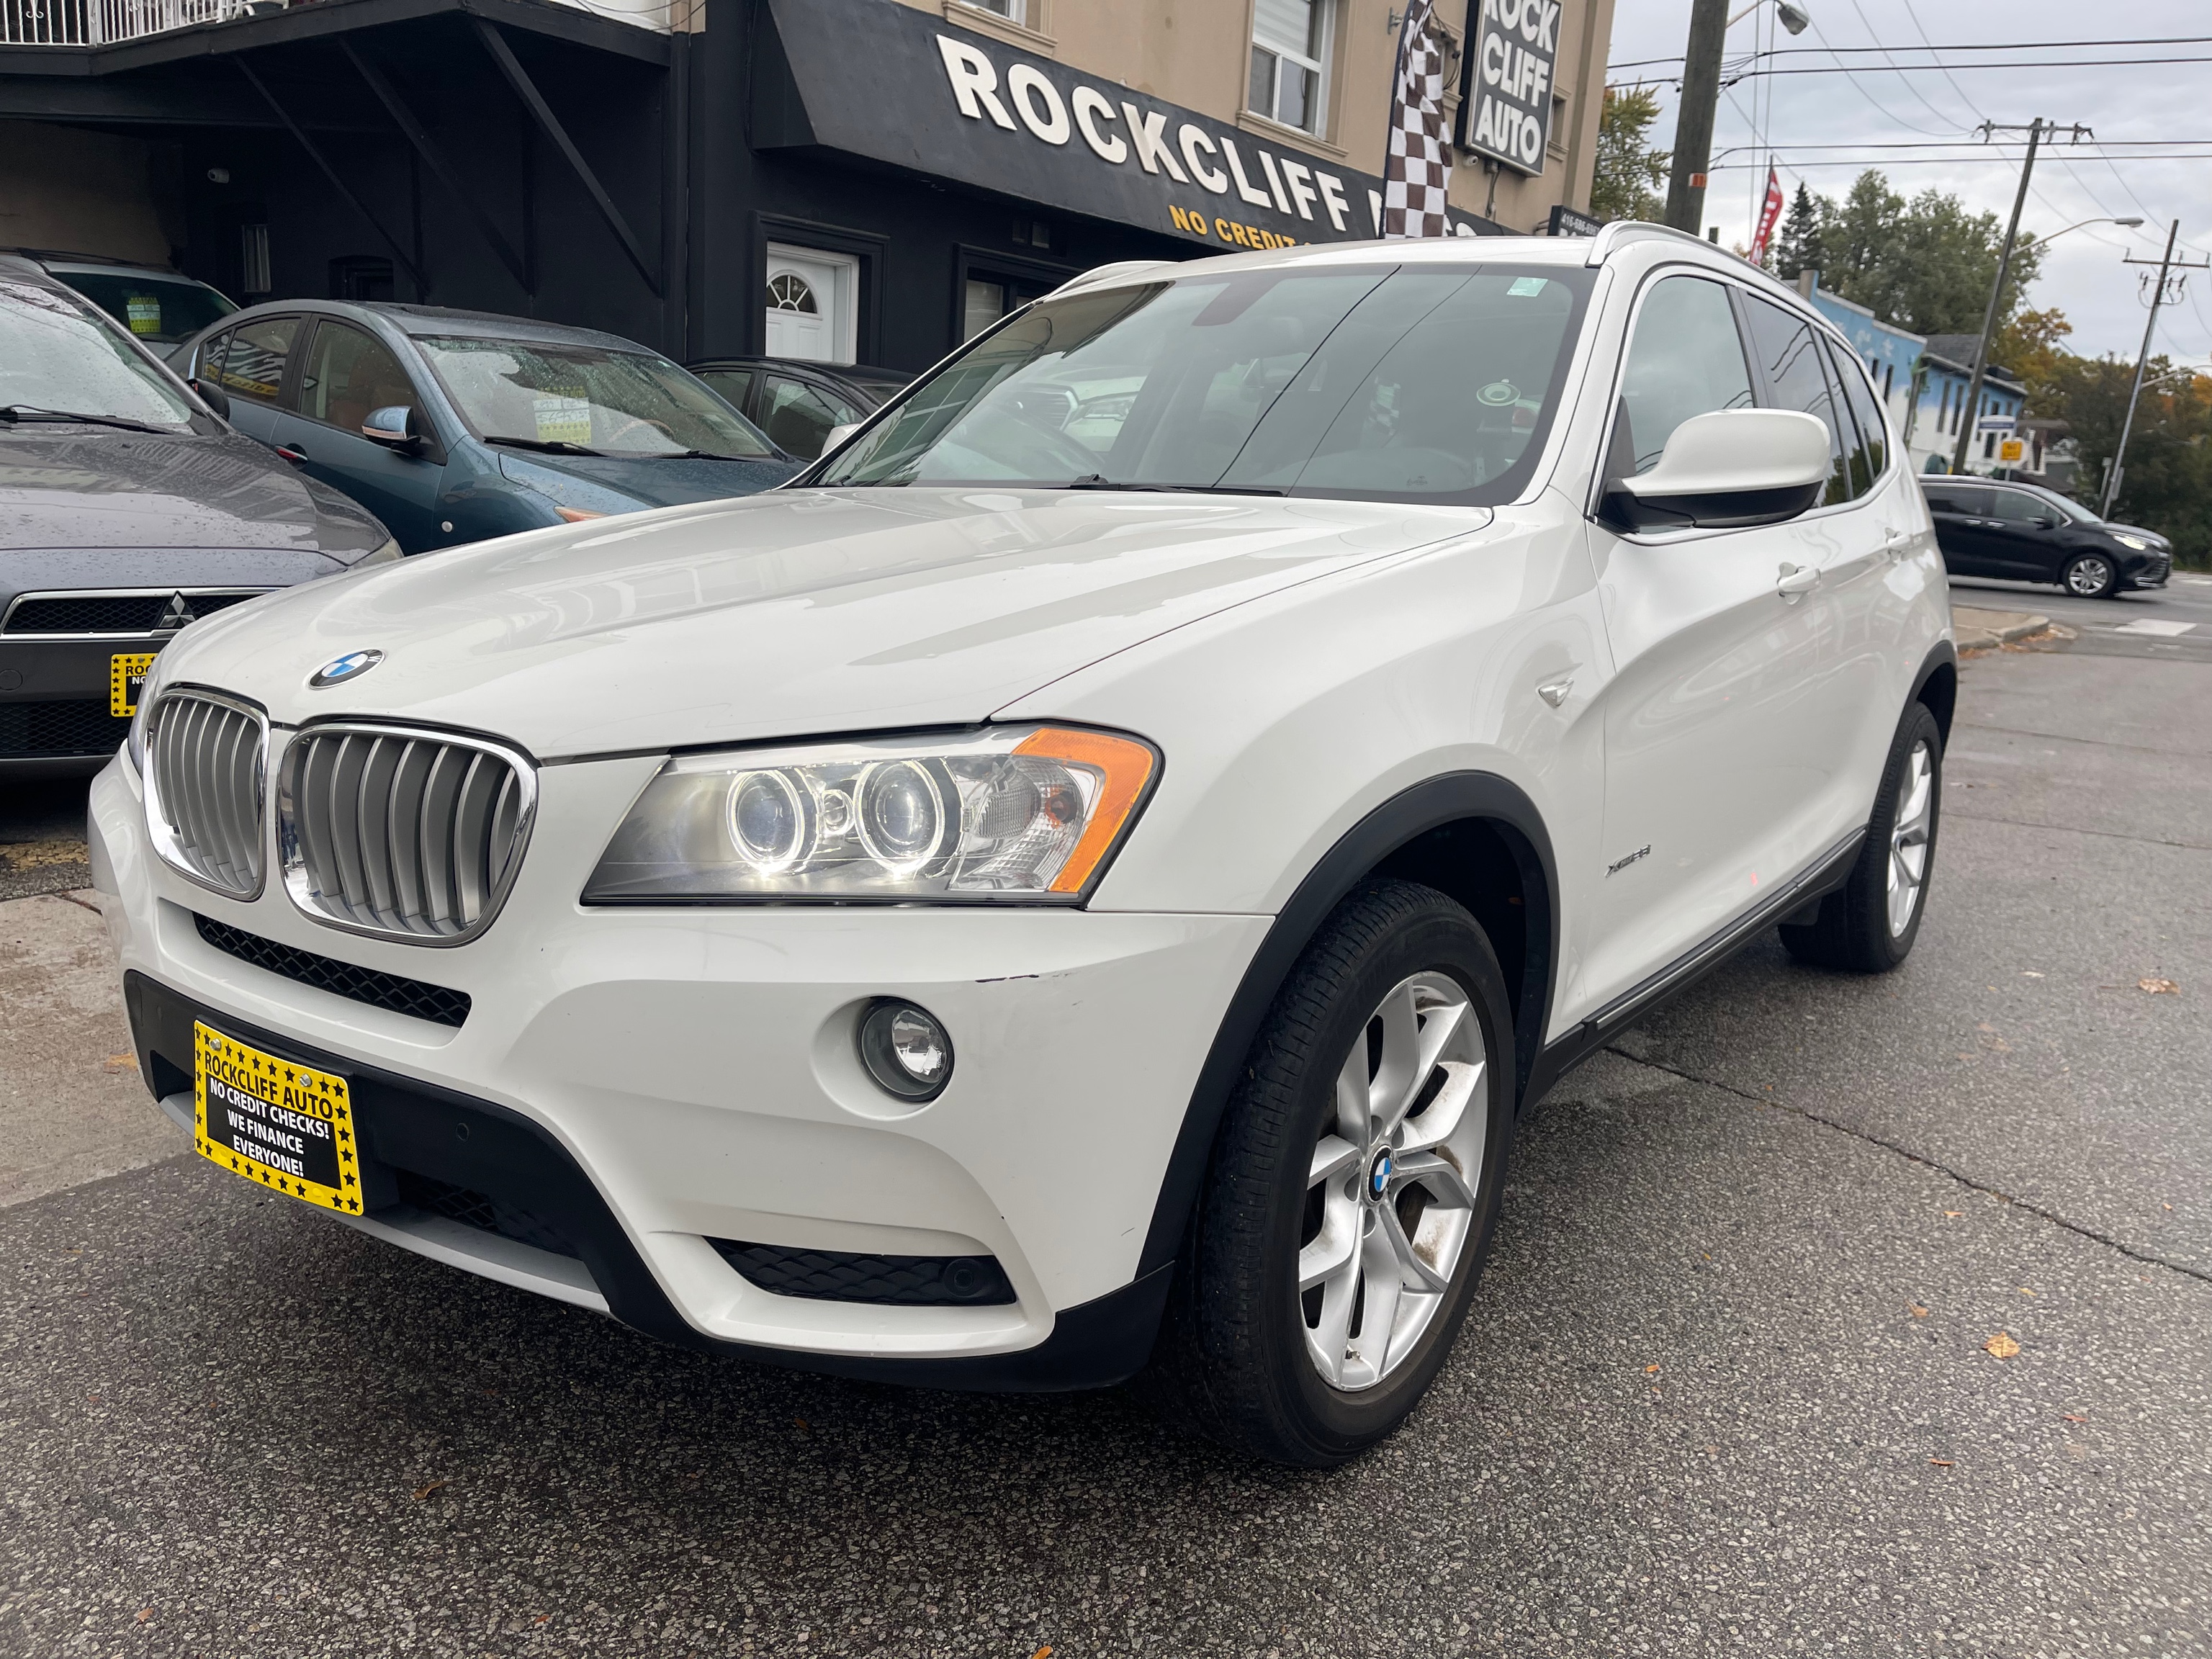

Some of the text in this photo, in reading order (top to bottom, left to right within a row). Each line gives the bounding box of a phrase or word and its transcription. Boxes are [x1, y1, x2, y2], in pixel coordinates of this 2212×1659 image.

[1483, 32, 1550, 107] CLIFF
[936, 34, 1350, 232] ROCKCLIFF
[1475, 94, 1542, 164] AUTO
[1169, 204, 1296, 250] NO CREDIT
[204, 1051, 333, 1120] ROCKCLIFF AUTO
[210, 1077, 330, 1140] NO CREDIT CHECKS!
[227, 1109, 304, 1154] WE FINANCE
[233, 1134, 304, 1177] EVERYONE!
